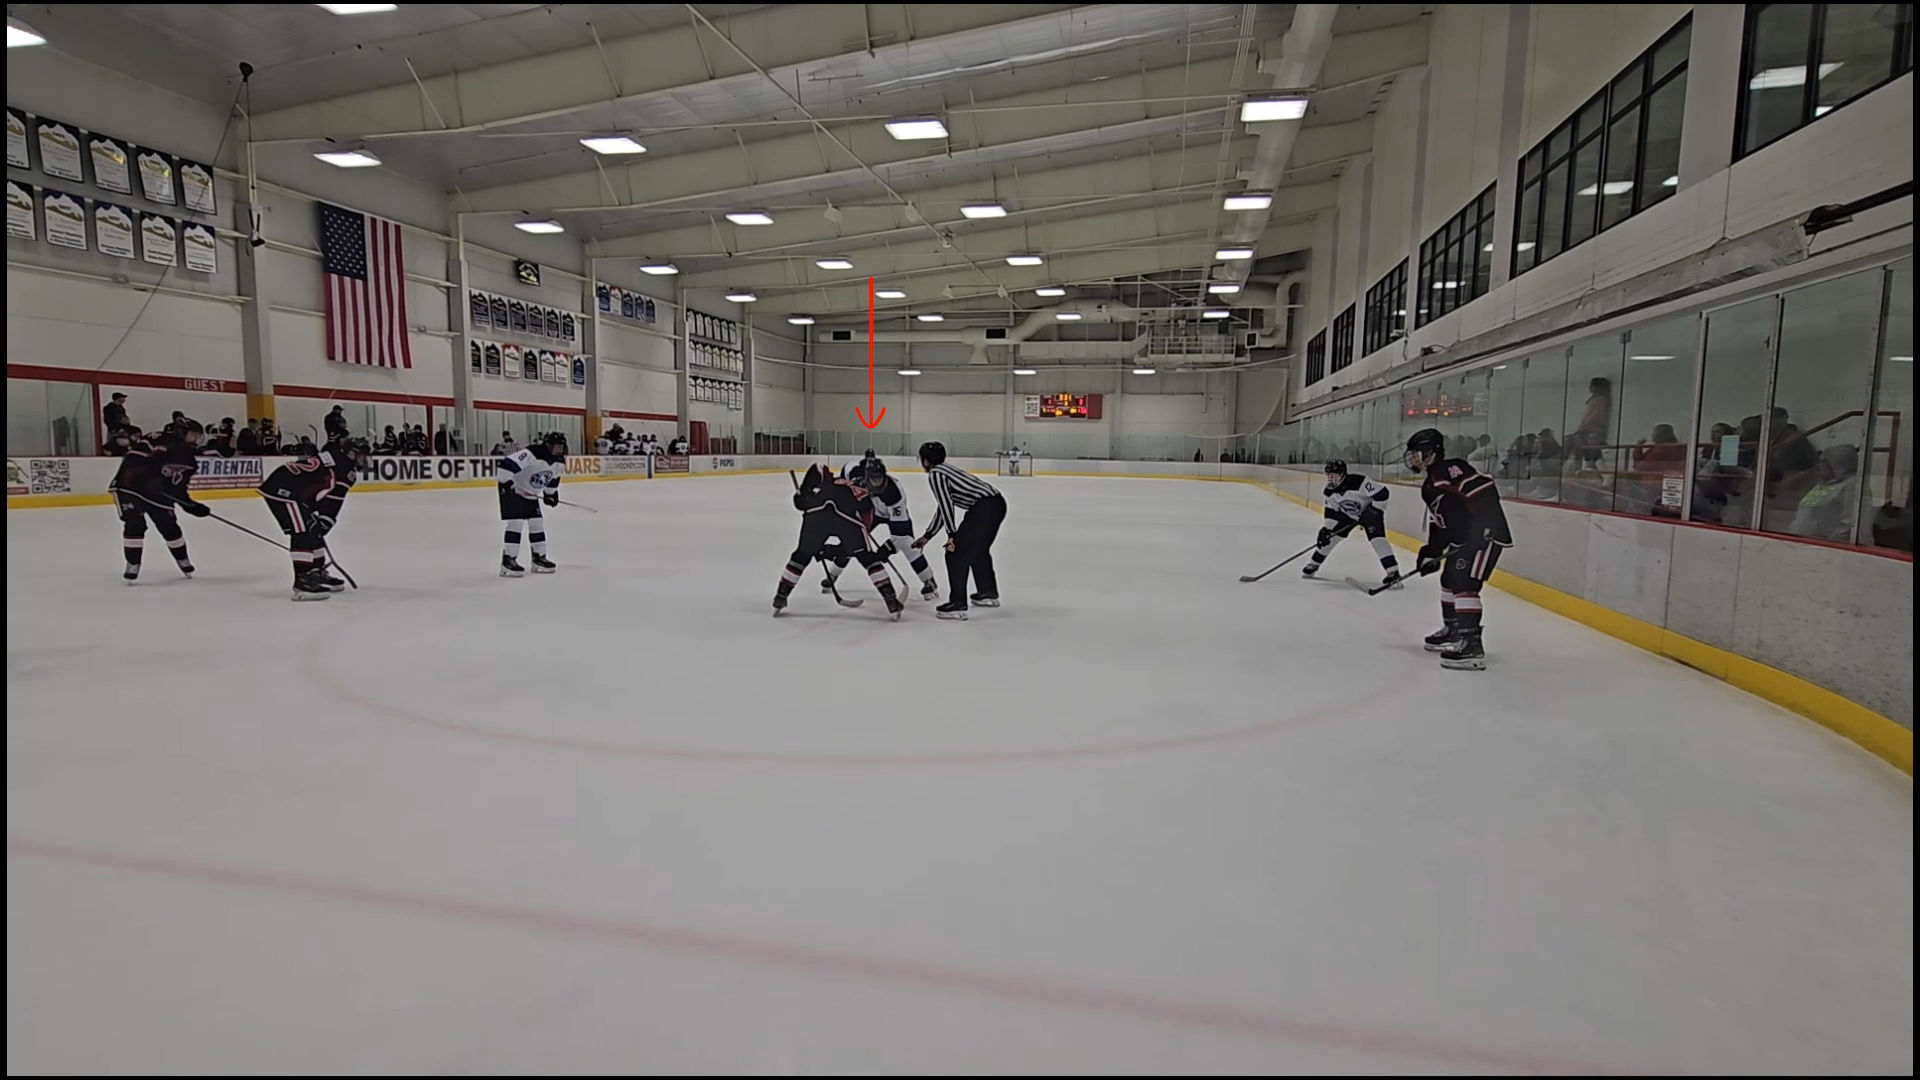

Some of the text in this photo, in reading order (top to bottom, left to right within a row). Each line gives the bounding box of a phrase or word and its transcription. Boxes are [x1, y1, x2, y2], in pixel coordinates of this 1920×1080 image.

[184, 379, 226, 392] GUEST
[213, 460, 260, 475] RENTAL
[719, 459, 735, 467] PEPSI
[362, 459, 433, 481] HOME
[438, 459, 465, 479] OF
[1365, 482, 1375, 492] 12
